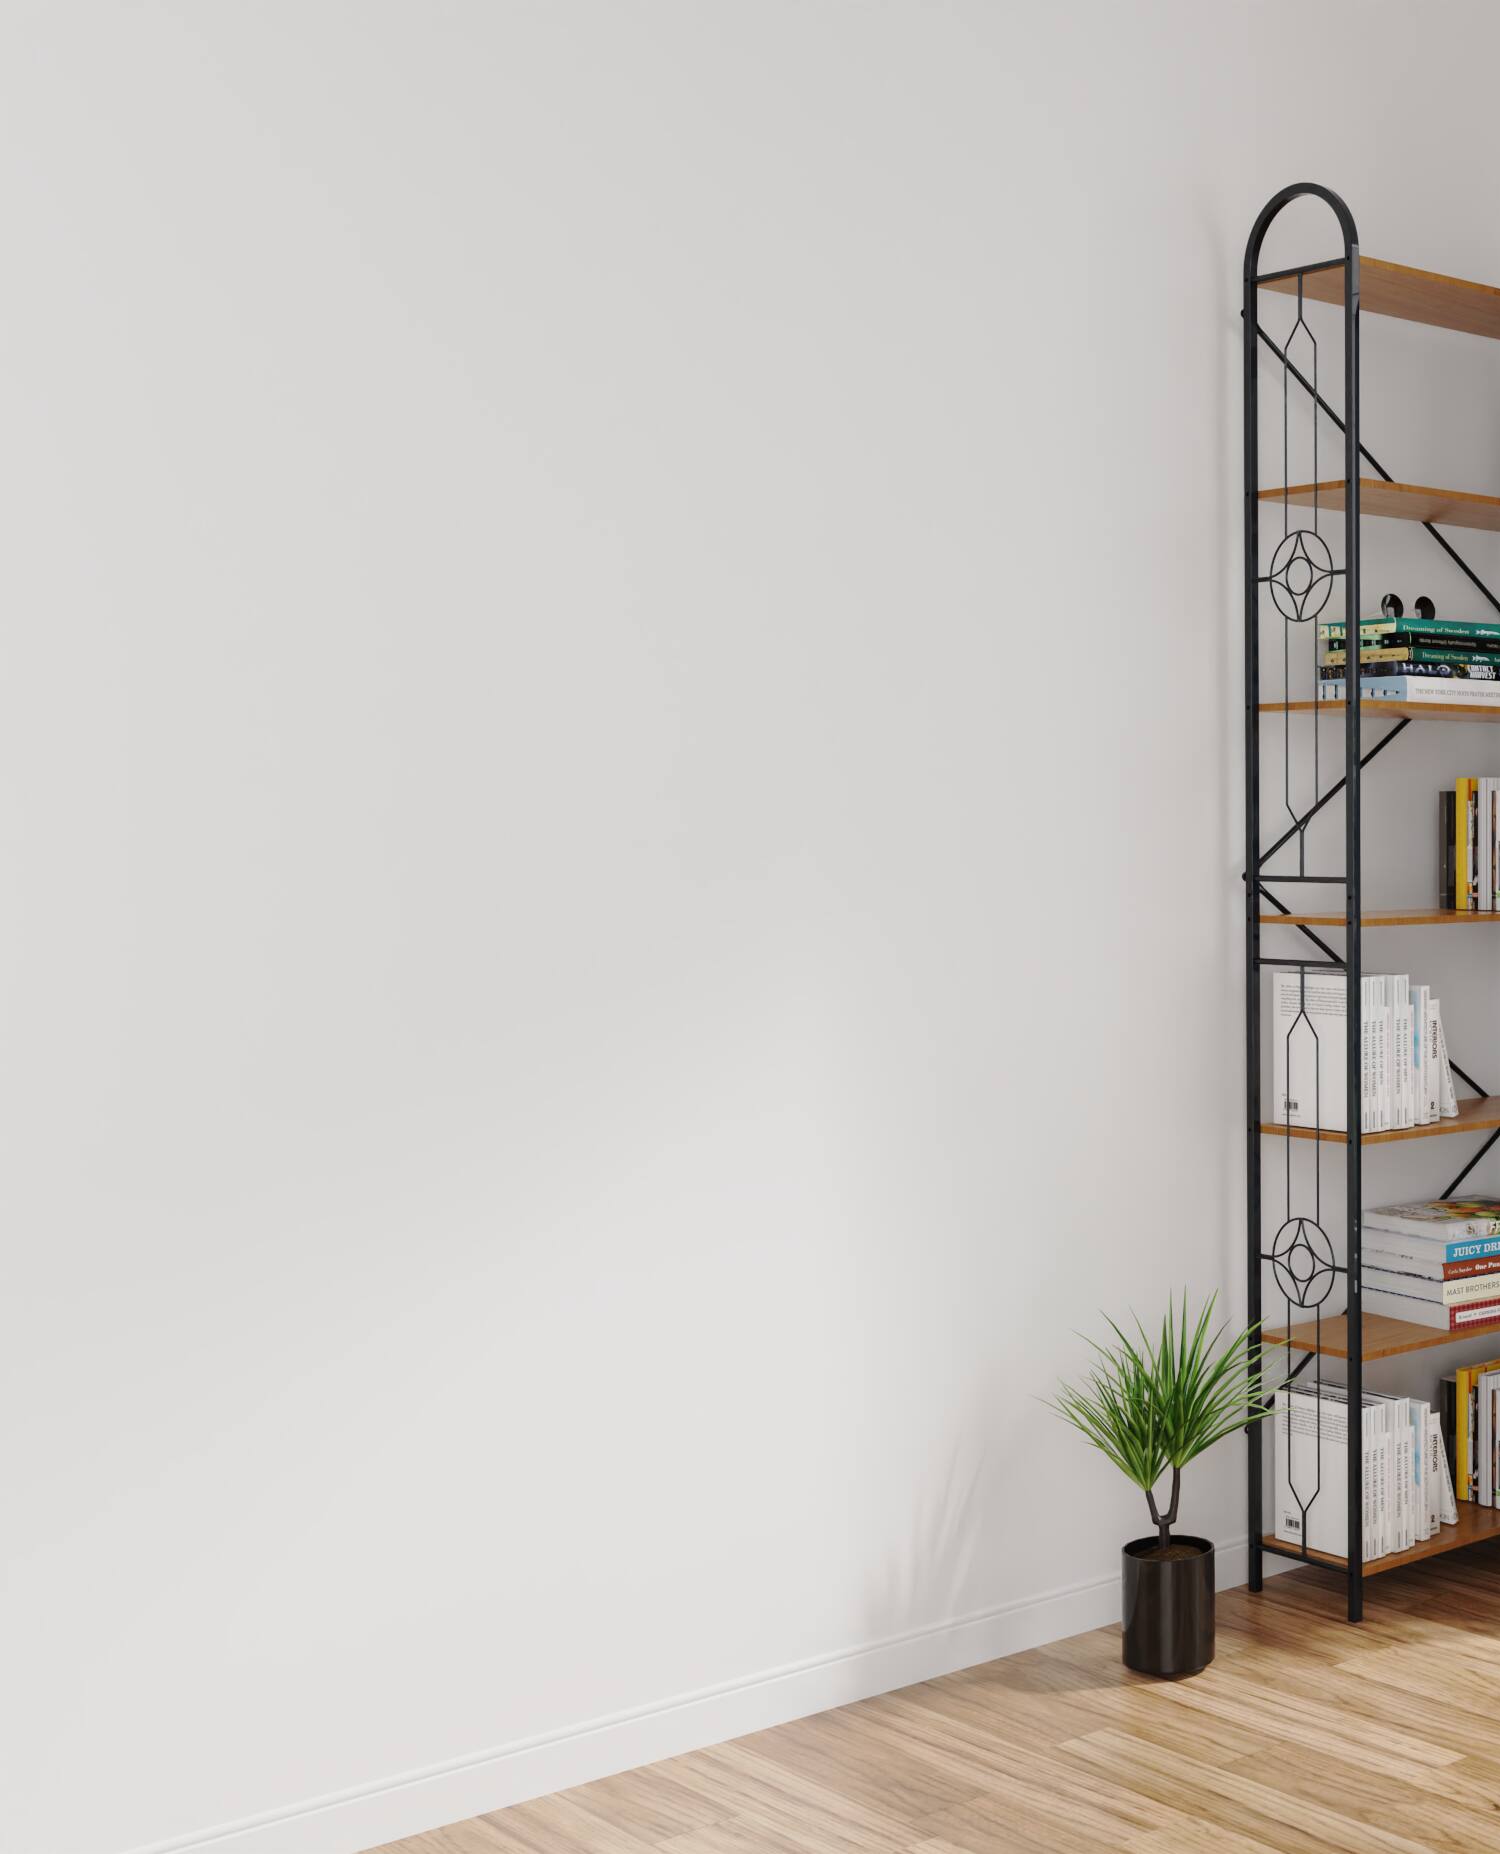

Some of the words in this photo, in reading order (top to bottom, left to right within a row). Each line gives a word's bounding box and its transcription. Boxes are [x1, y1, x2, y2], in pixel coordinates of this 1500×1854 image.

[1402, 662, 1451, 676] HALO
[1453, 1244, 1481, 1257] JUICY
[1475, 1263, 1487, 1271] One
[1447, 1287, 1464, 1296] MAST
[1465, 1281, 1500, 1293] BROTHERS
